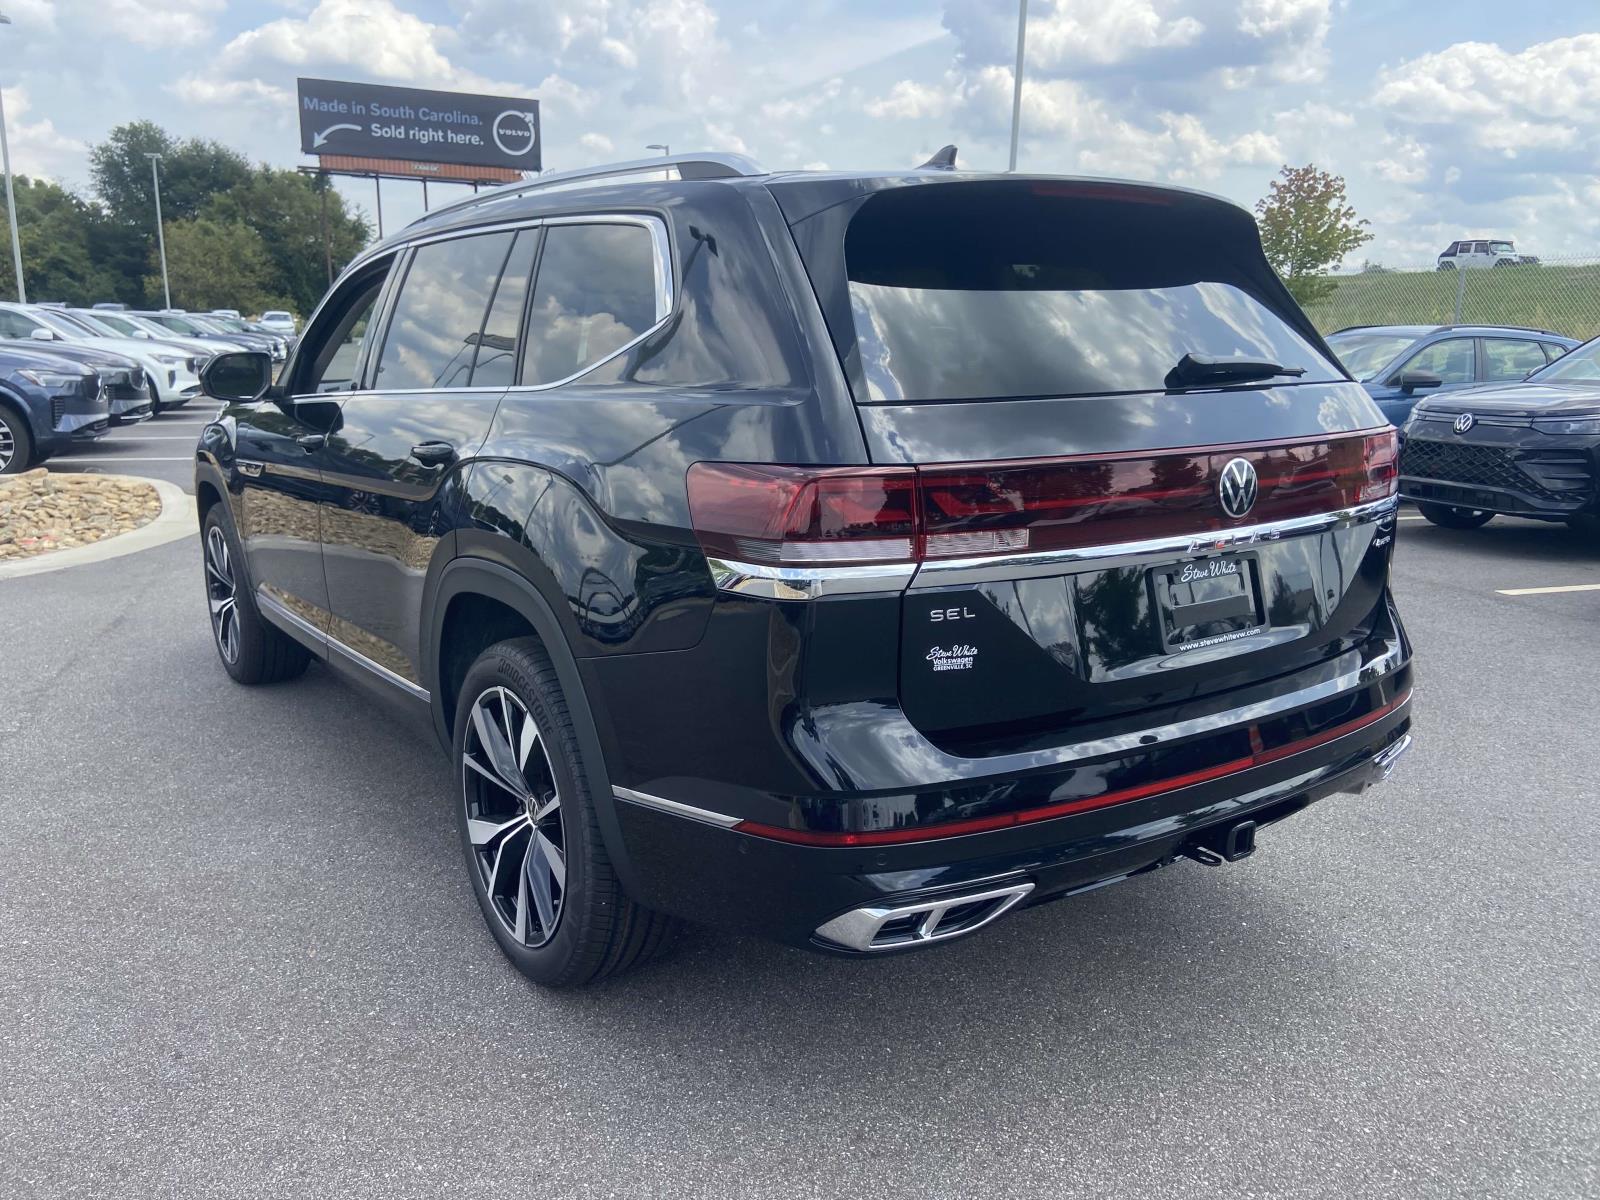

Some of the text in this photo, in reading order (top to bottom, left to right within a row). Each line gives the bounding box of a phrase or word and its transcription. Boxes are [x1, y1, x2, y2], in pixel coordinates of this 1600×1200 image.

[303, 97, 483, 126] Made in South Carolina.
[371, 124, 484, 146] Sold right here.
[498, 129, 530, 137] VOLVO
[1181, 560, 1237, 582] Steve White
[930, 606, 976, 622] SEL
[1179, 628, 1261, 652] www.stevewhitevw.com
[926, 645, 978, 660] Steve White
[933, 656, 973, 665] Volkswagen
[497, 658, 554, 735] BRIDGESTONE
